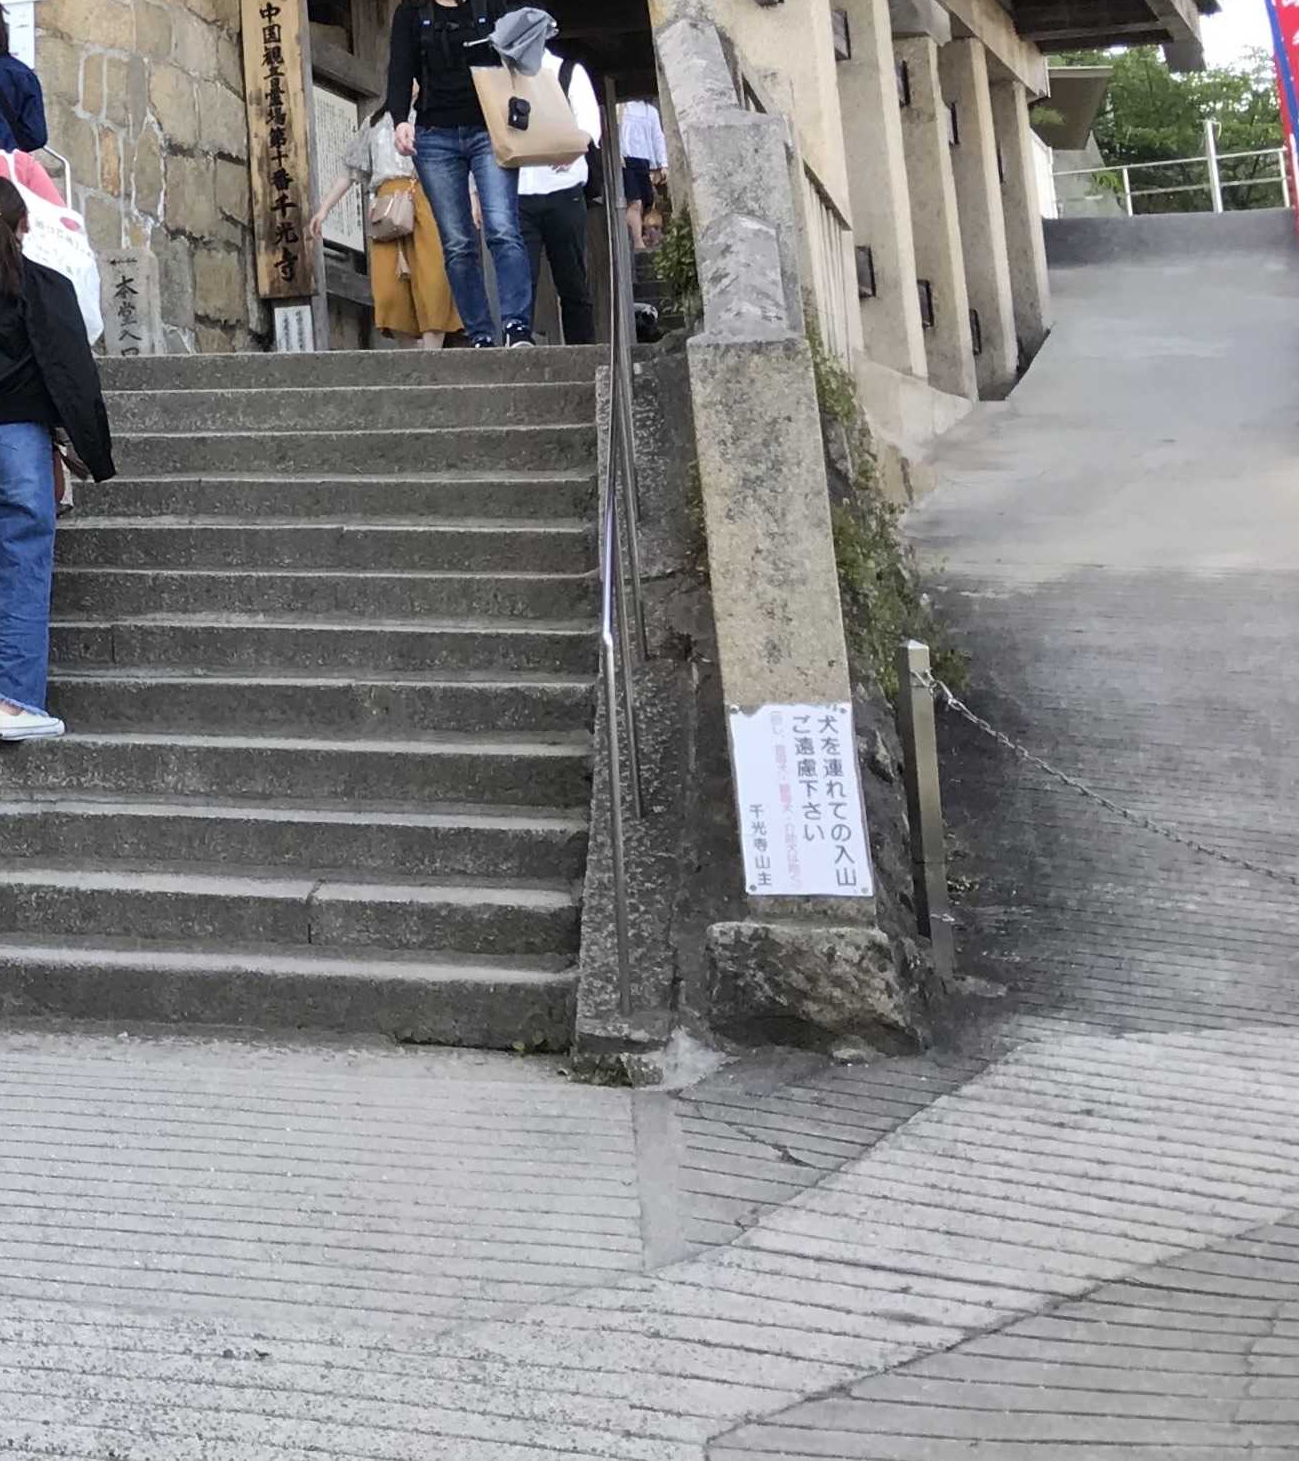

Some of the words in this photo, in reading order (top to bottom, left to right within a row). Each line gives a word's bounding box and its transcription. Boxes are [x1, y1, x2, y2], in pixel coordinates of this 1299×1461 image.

[792, 714, 836, 843] ご遠慮下さい
[817, 714, 858, 888] 犬を連れての入山
[749, 802, 773, 887] 千光寺山主
